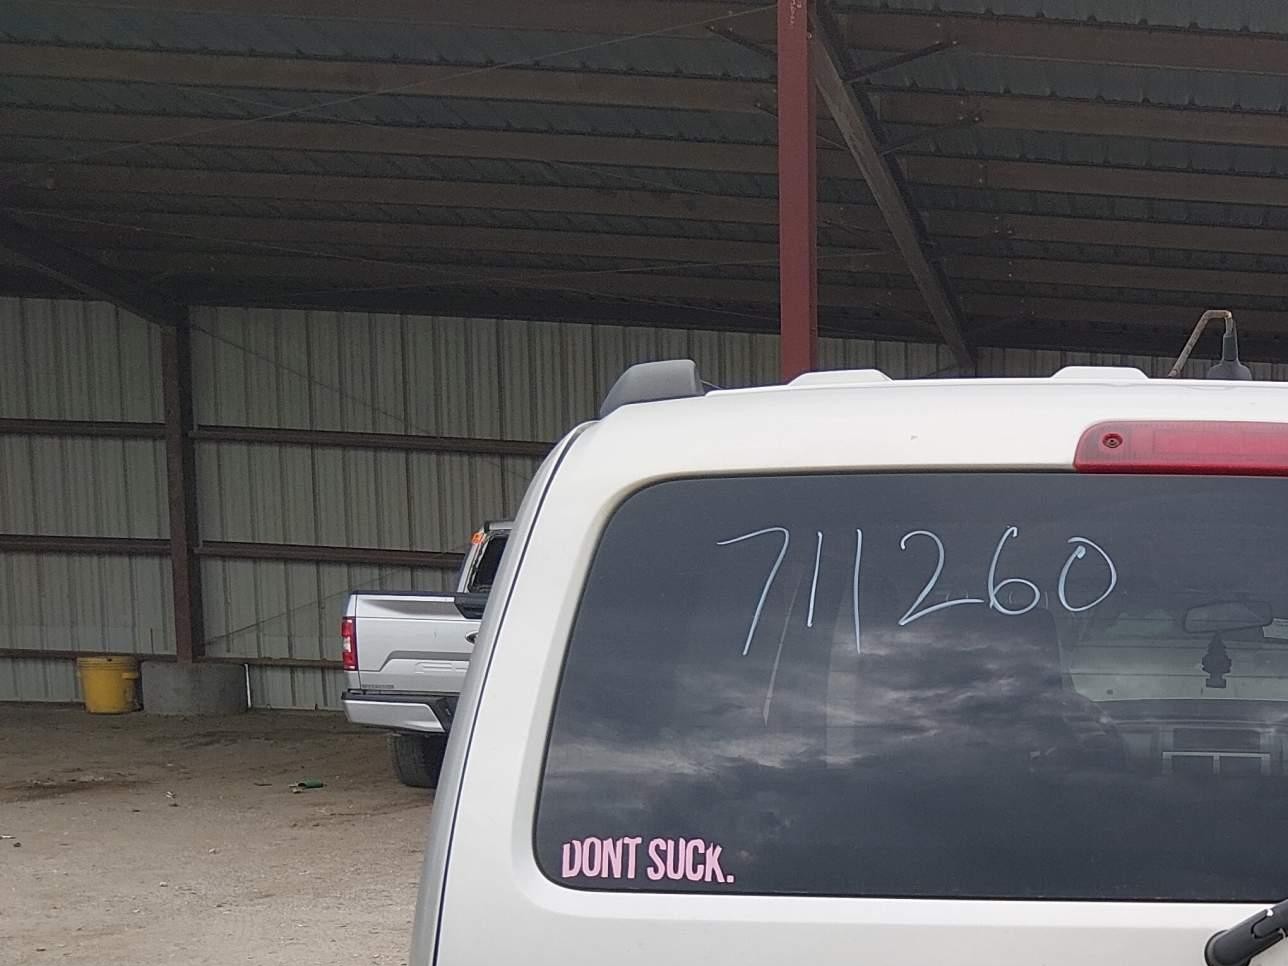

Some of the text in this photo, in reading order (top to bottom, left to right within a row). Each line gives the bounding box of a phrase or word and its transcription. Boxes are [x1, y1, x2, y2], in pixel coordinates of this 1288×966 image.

[716, 526, 1117, 656] 711260
[562, 836, 735, 883] DONT SUCK.
